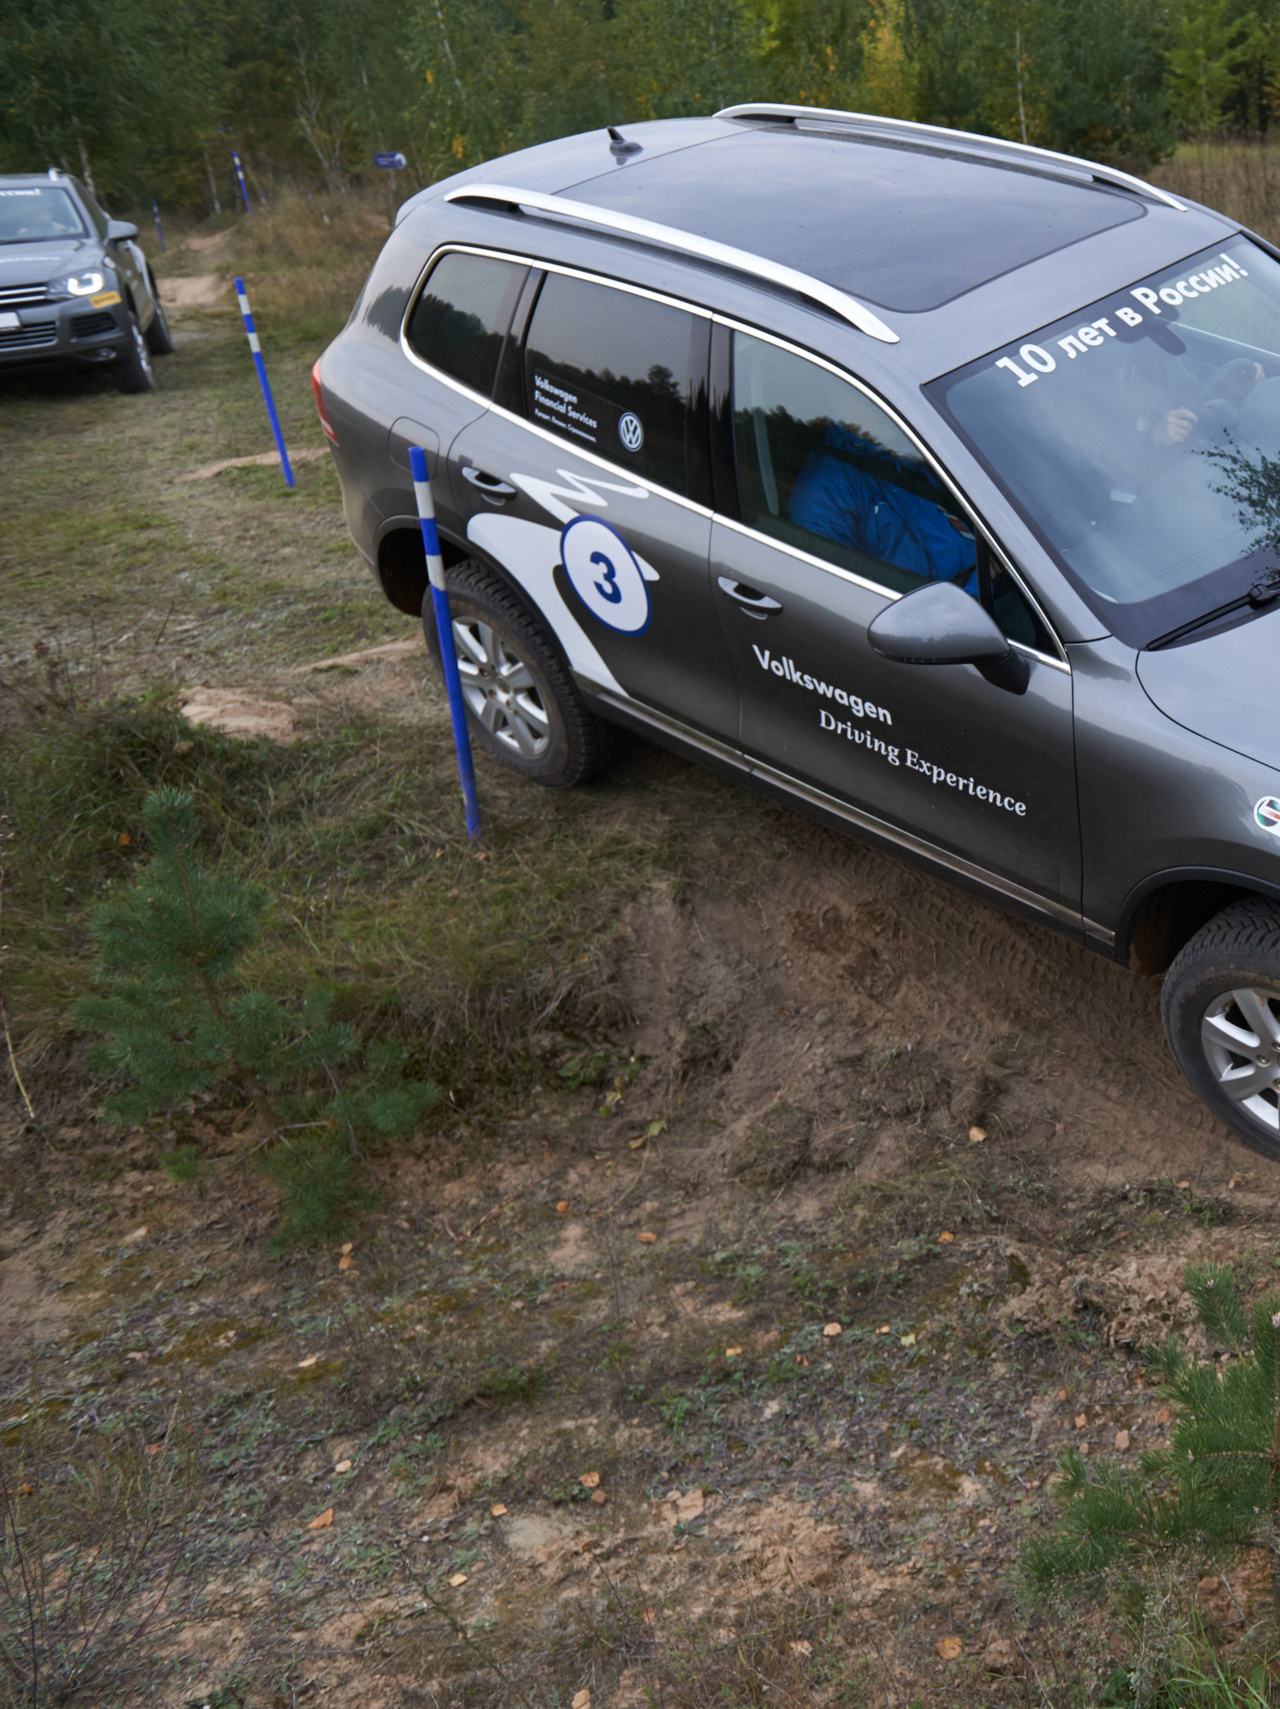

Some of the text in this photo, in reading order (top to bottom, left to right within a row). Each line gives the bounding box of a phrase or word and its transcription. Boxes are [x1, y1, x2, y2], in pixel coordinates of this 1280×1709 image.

[995, 253, 1249, 388] 10 лет в России!
[534, 375, 577, 404] Volkswagen
[534, 390, 566, 414] Financial
[567, 406, 597, 428] Services
[590, 551, 622, 604] 3
[752, 644, 893, 725] Volkswagen
[819, 709, 1027, 817] Driving Experience
